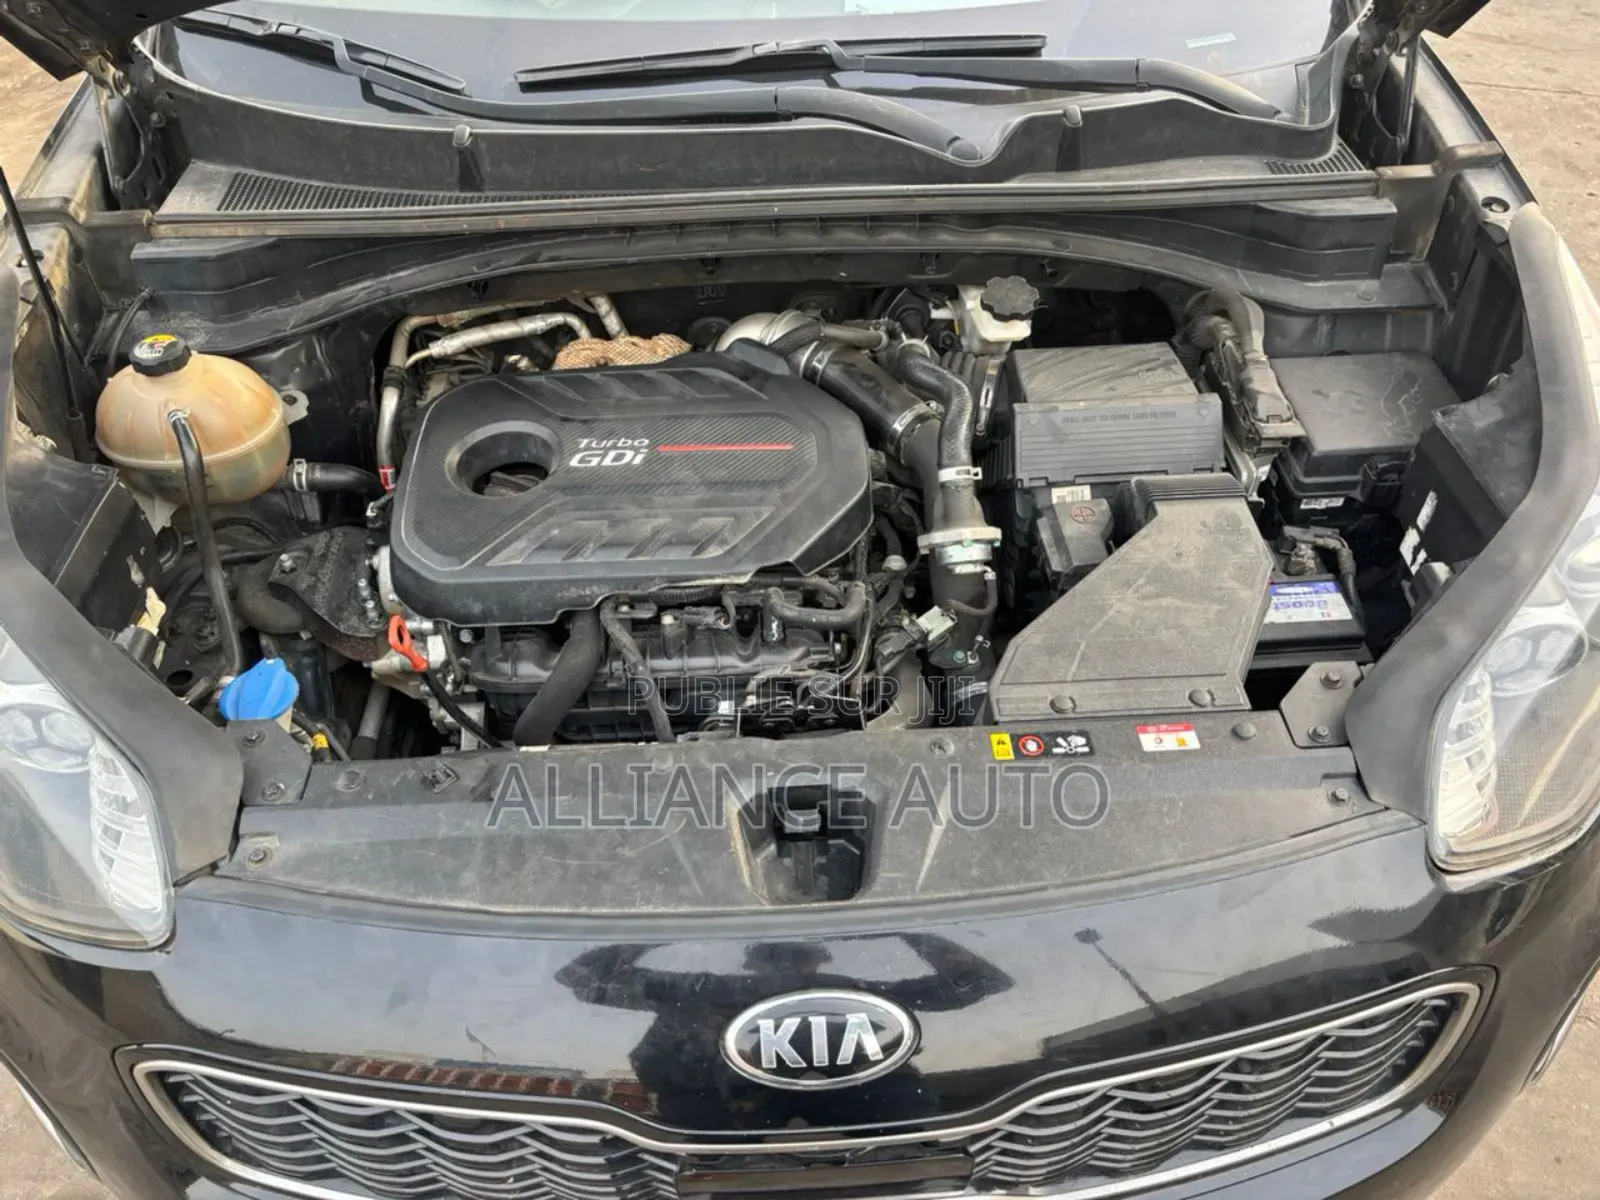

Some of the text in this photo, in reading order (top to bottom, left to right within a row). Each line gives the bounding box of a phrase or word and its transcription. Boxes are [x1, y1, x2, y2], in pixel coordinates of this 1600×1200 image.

[578, 437, 650, 449] Turbo
[569, 448, 649, 468] GDi
[757, 1012, 885, 1069] KIA
